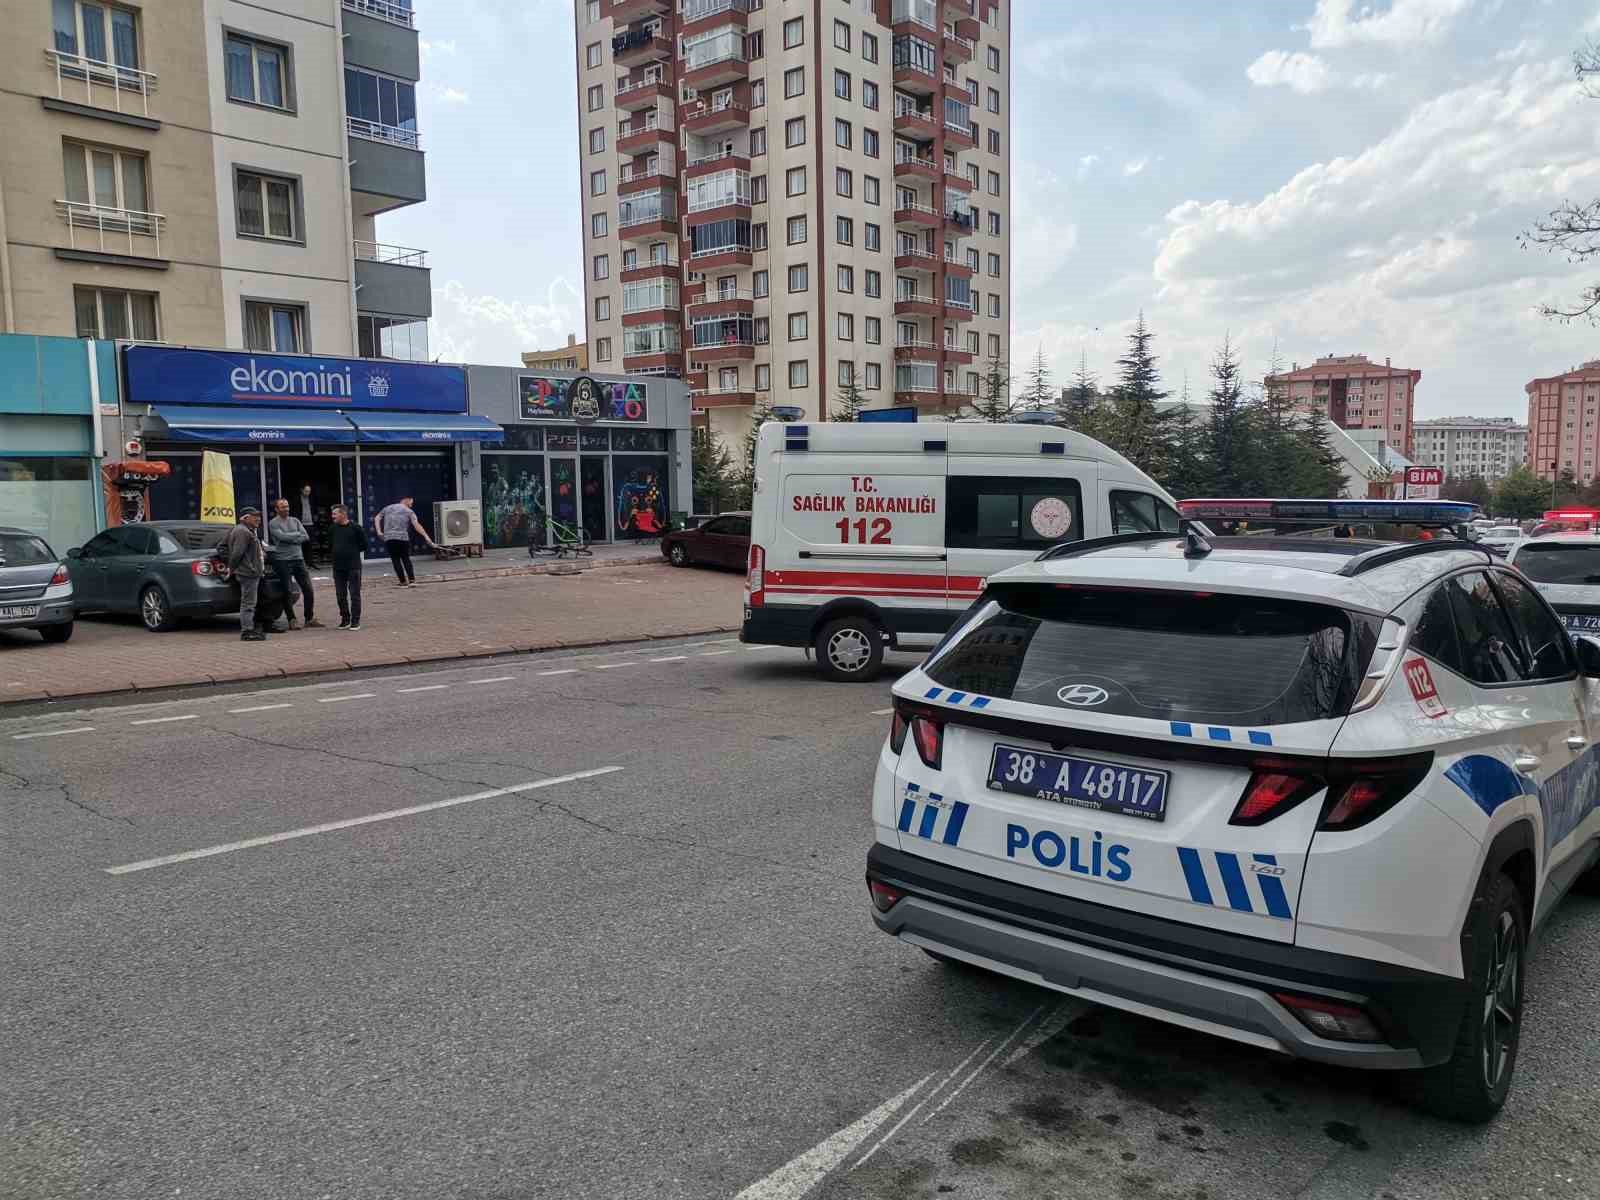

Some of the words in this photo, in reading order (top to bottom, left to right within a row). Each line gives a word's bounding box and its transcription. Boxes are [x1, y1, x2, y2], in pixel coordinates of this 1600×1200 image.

[230, 359, 352, 396] ekomini
[248, 430, 280, 439] ekomini
[548, 434, 577, 445] PS5
[852, 477, 877, 493] T.C.
[793, 491, 845, 512] SAĞLIK
[856, 494, 936, 514] BAKANLIĞI
[835, 517, 892, 545] 112
[1573, 616, 1580, 627] A
[1408, 665, 1433, 696] 112
[1004, 752, 1035, 784] 38
[1054, 761, 1070, 792] A
[1081, 765, 1161, 806] 48117
[1036, 789, 1061, 802] ATA
[1006, 823, 1132, 882] POLİS
